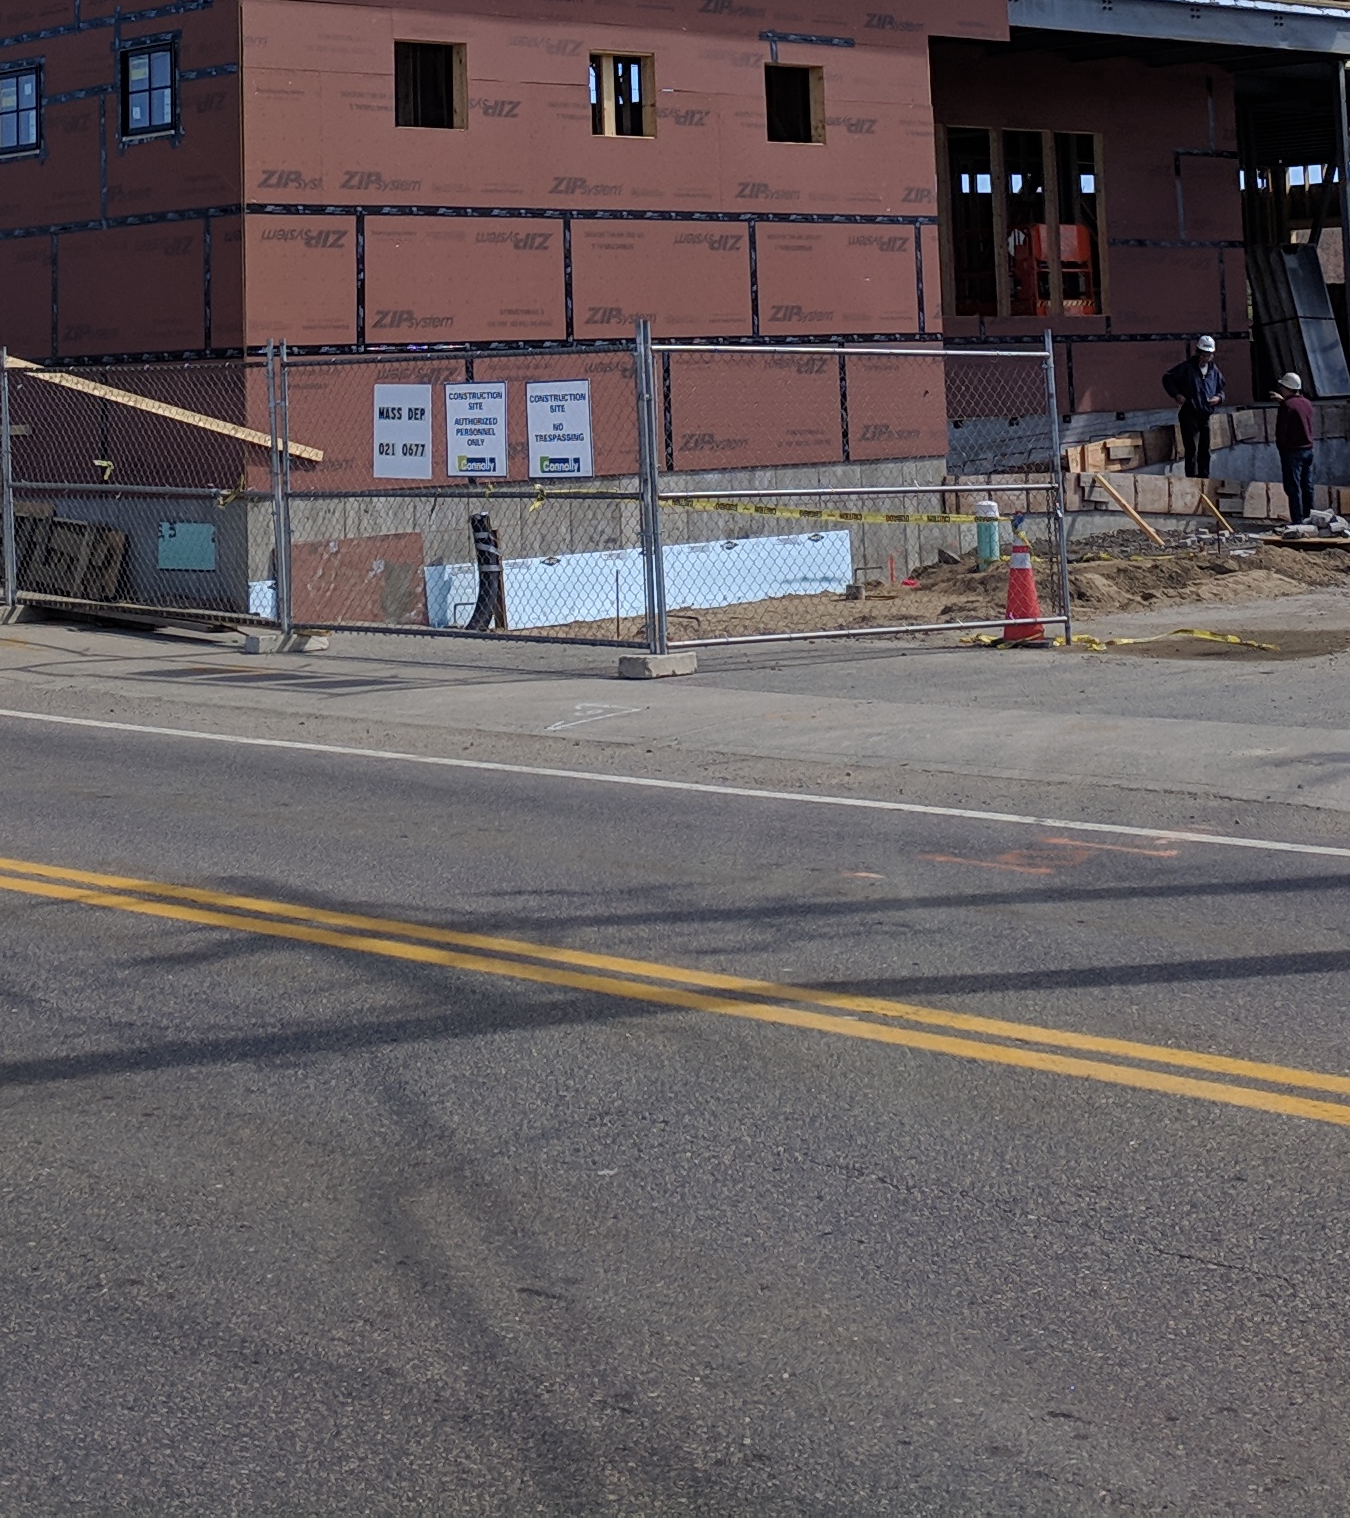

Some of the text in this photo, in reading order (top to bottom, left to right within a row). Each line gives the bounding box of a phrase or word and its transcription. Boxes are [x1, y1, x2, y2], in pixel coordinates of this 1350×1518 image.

[449, 391, 502, 400] CONSTRUCTION
[530, 393, 586, 403] CONSTRUCTION
[468, 402, 483, 410] SITE
[550, 404, 565, 413] SITE
[378, 407, 426, 421] MASS DEP
[454, 417, 497, 425] AUTHORIZED
[553, 423, 563, 431] NO
[456, 428, 496, 436] PERSONNEL
[467, 438, 485, 446] ONLY
[535, 433, 584, 443] TRESPASSING
[379, 443, 426, 457] 021 0677
[461, 458, 496, 472] Connolly
[542, 458, 579, 473] Connolly
